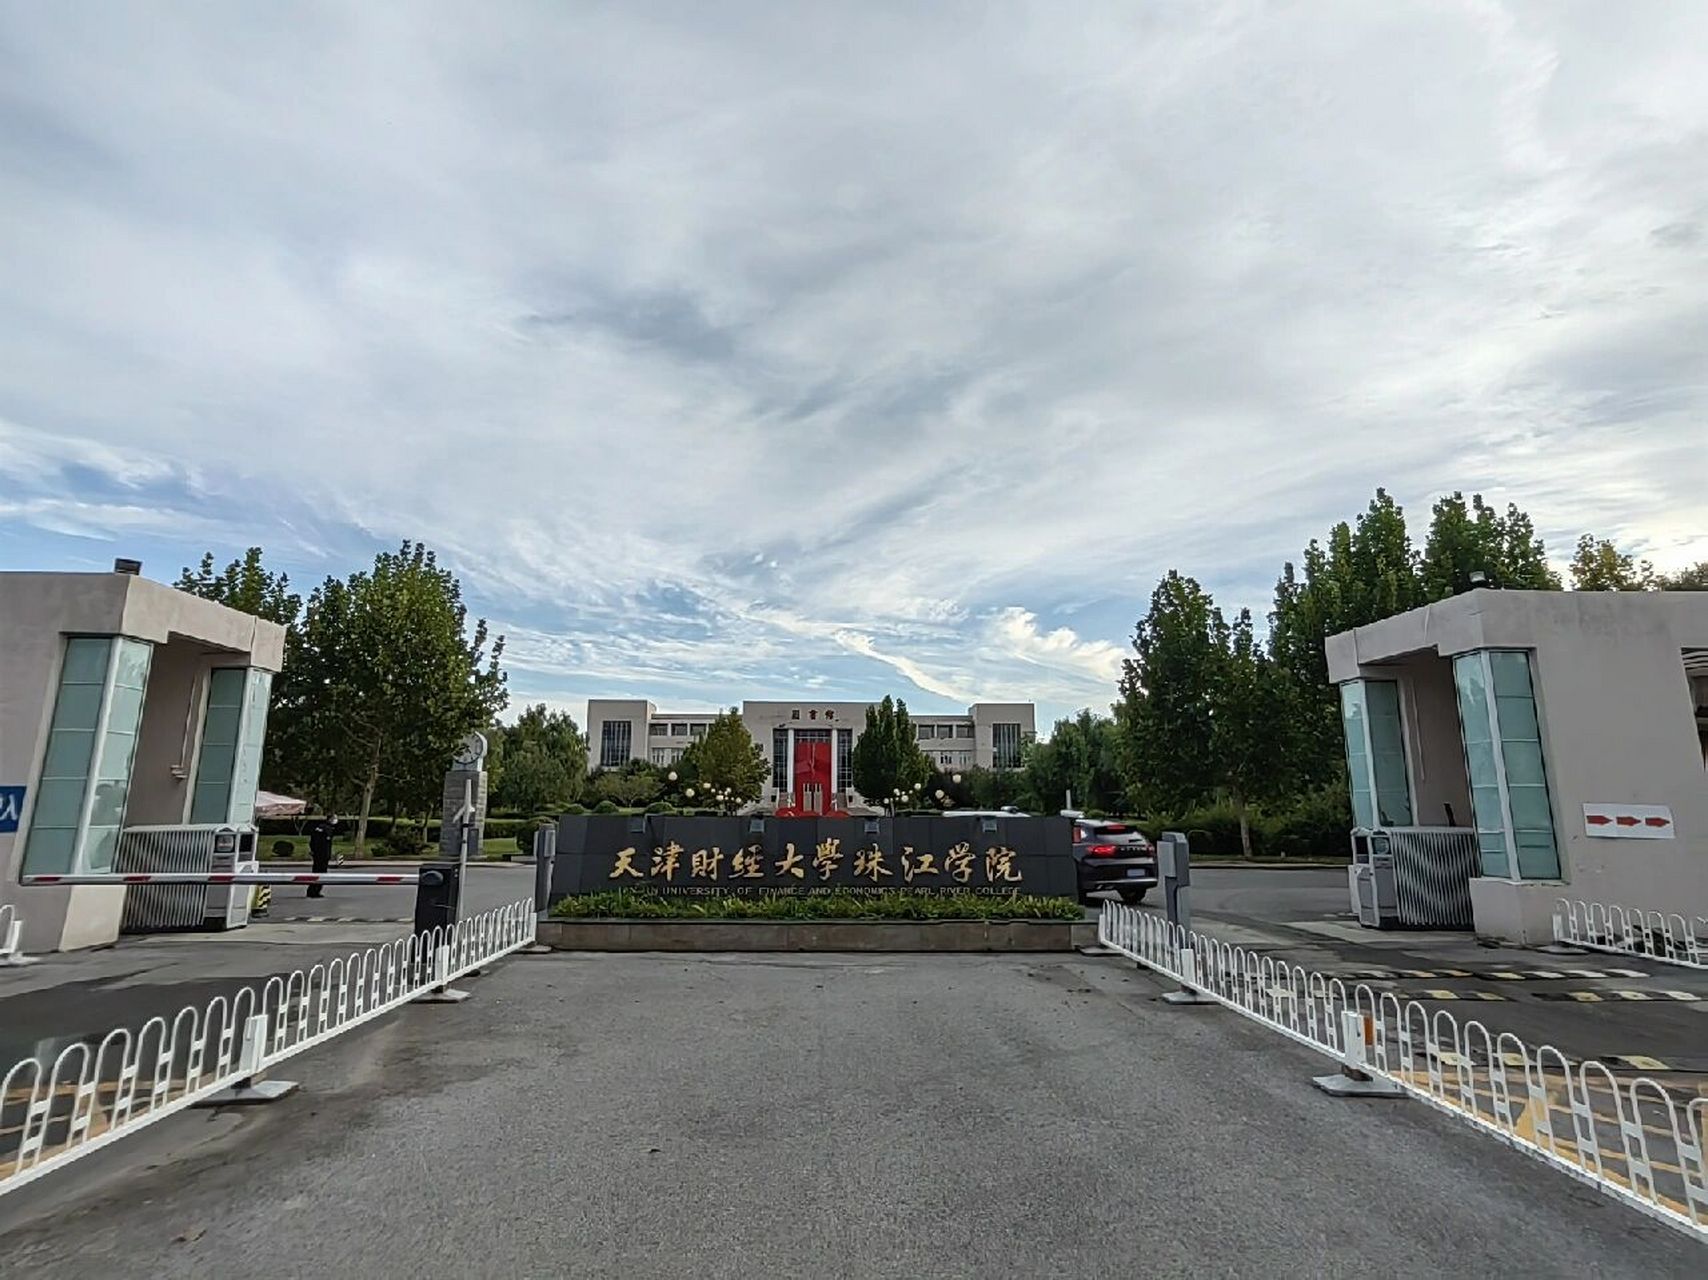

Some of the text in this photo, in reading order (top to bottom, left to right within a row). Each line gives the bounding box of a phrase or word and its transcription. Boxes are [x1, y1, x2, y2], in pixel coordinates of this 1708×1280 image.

[662, 886, 729, 897] UNIVERSITY
[737, 886, 753, 896] OF
[758, 886, 806, 897] FINANCE
[807, 886, 831, 896] AND
[900, 886, 935, 896] PEARL
[939, 886, 971, 896] RIVER
[975, 886, 1022, 896] COLLEGE
